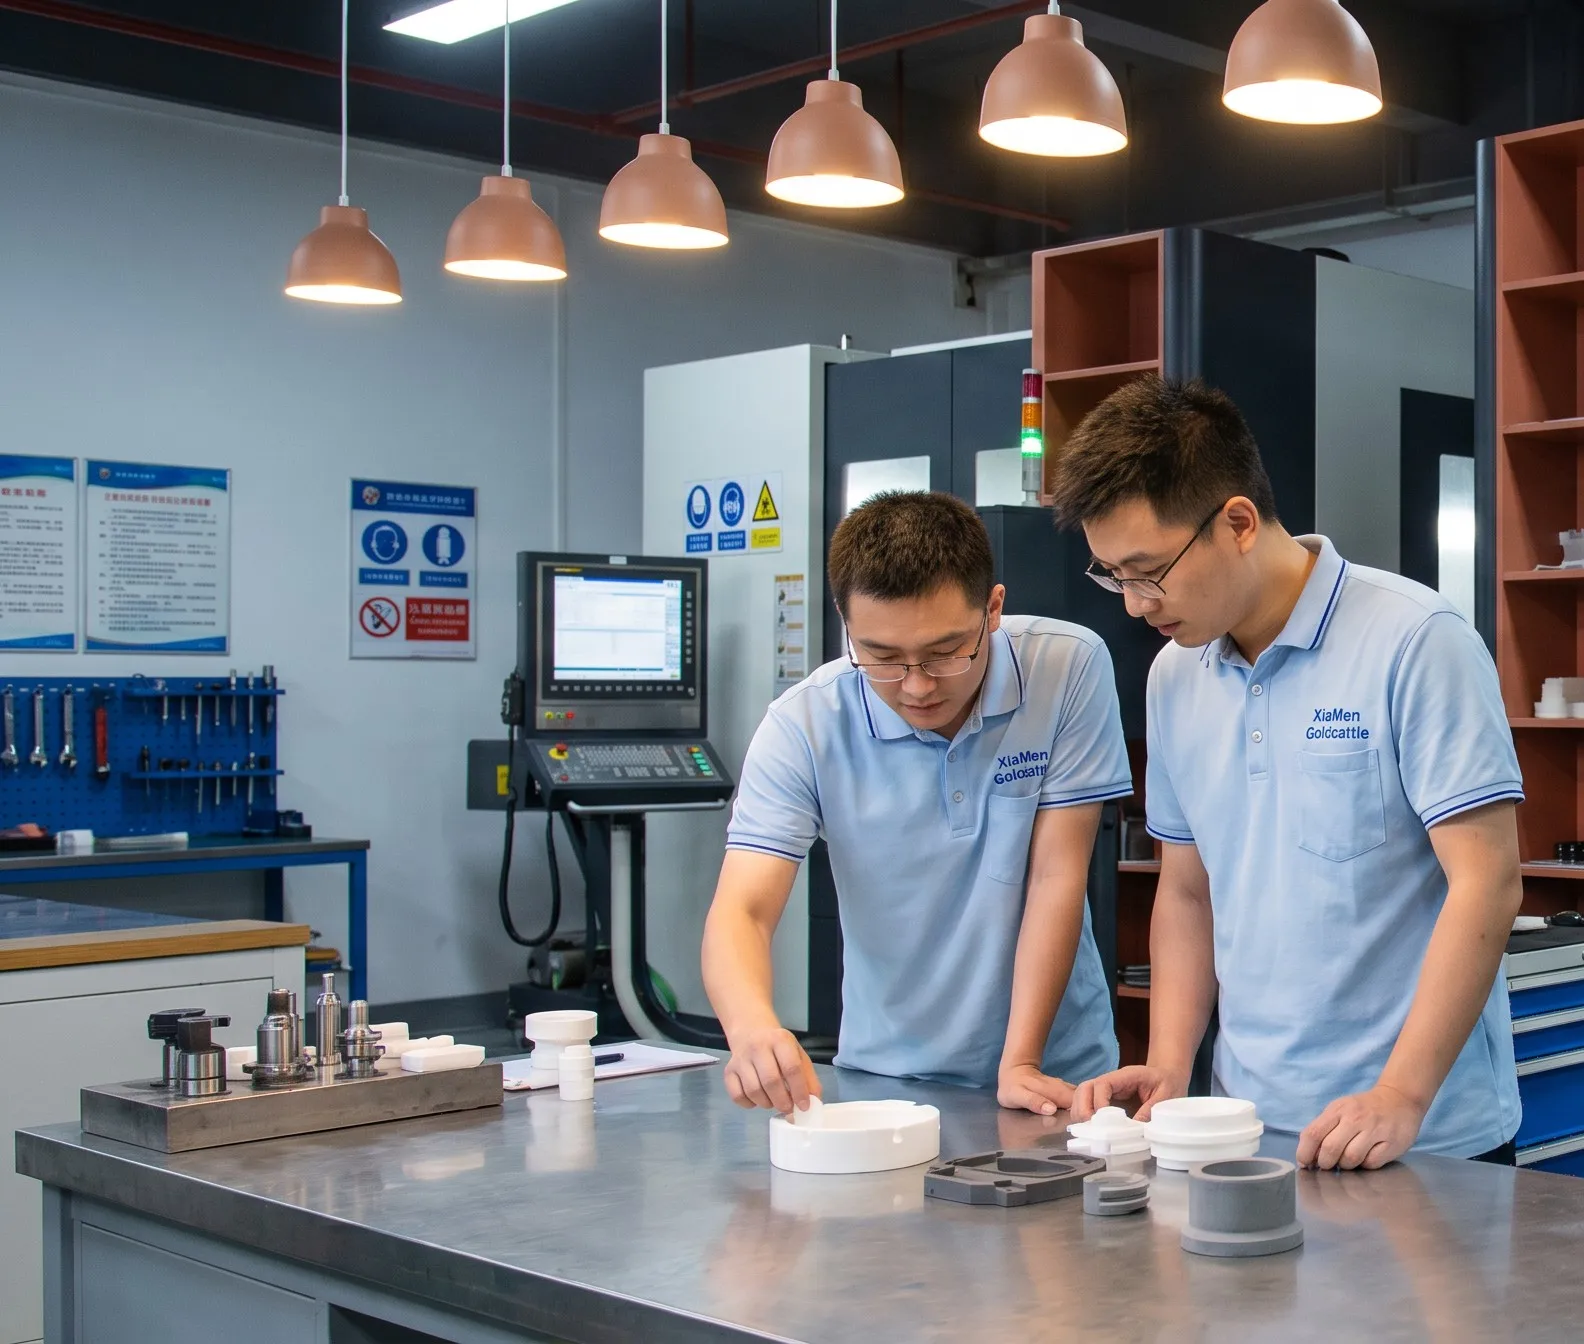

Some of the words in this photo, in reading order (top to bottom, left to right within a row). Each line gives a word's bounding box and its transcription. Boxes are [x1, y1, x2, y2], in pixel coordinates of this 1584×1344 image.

[1313, 708, 1361, 722] XiaMen
[1306, 726, 1369, 740] Goldcattle
[997, 750, 1049, 769] XiaMen
